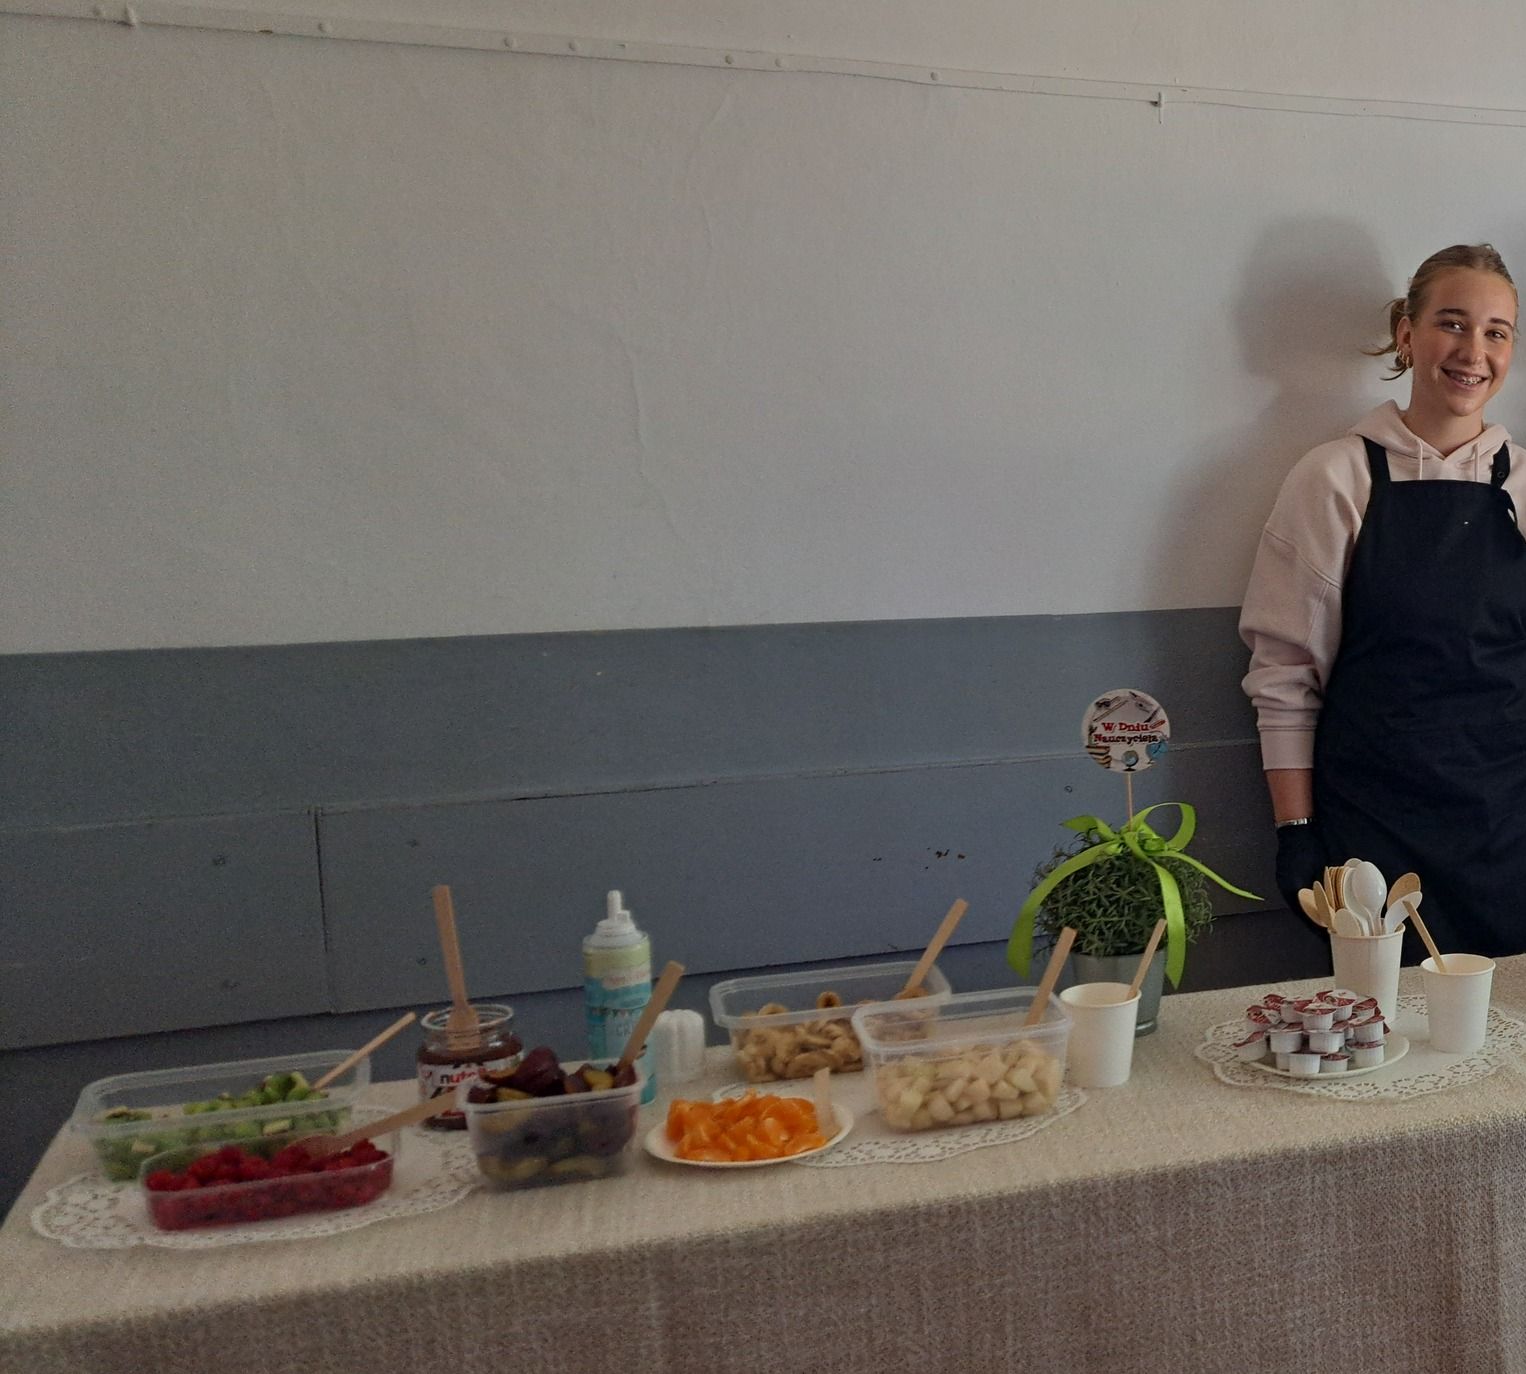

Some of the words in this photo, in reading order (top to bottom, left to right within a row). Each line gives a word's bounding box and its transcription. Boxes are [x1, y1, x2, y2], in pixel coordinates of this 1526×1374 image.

[1102, 722, 1115, 732] W
[1118, 722, 1149, 732] Dniu
[1093, 733, 1158, 745] Nauczyciela
